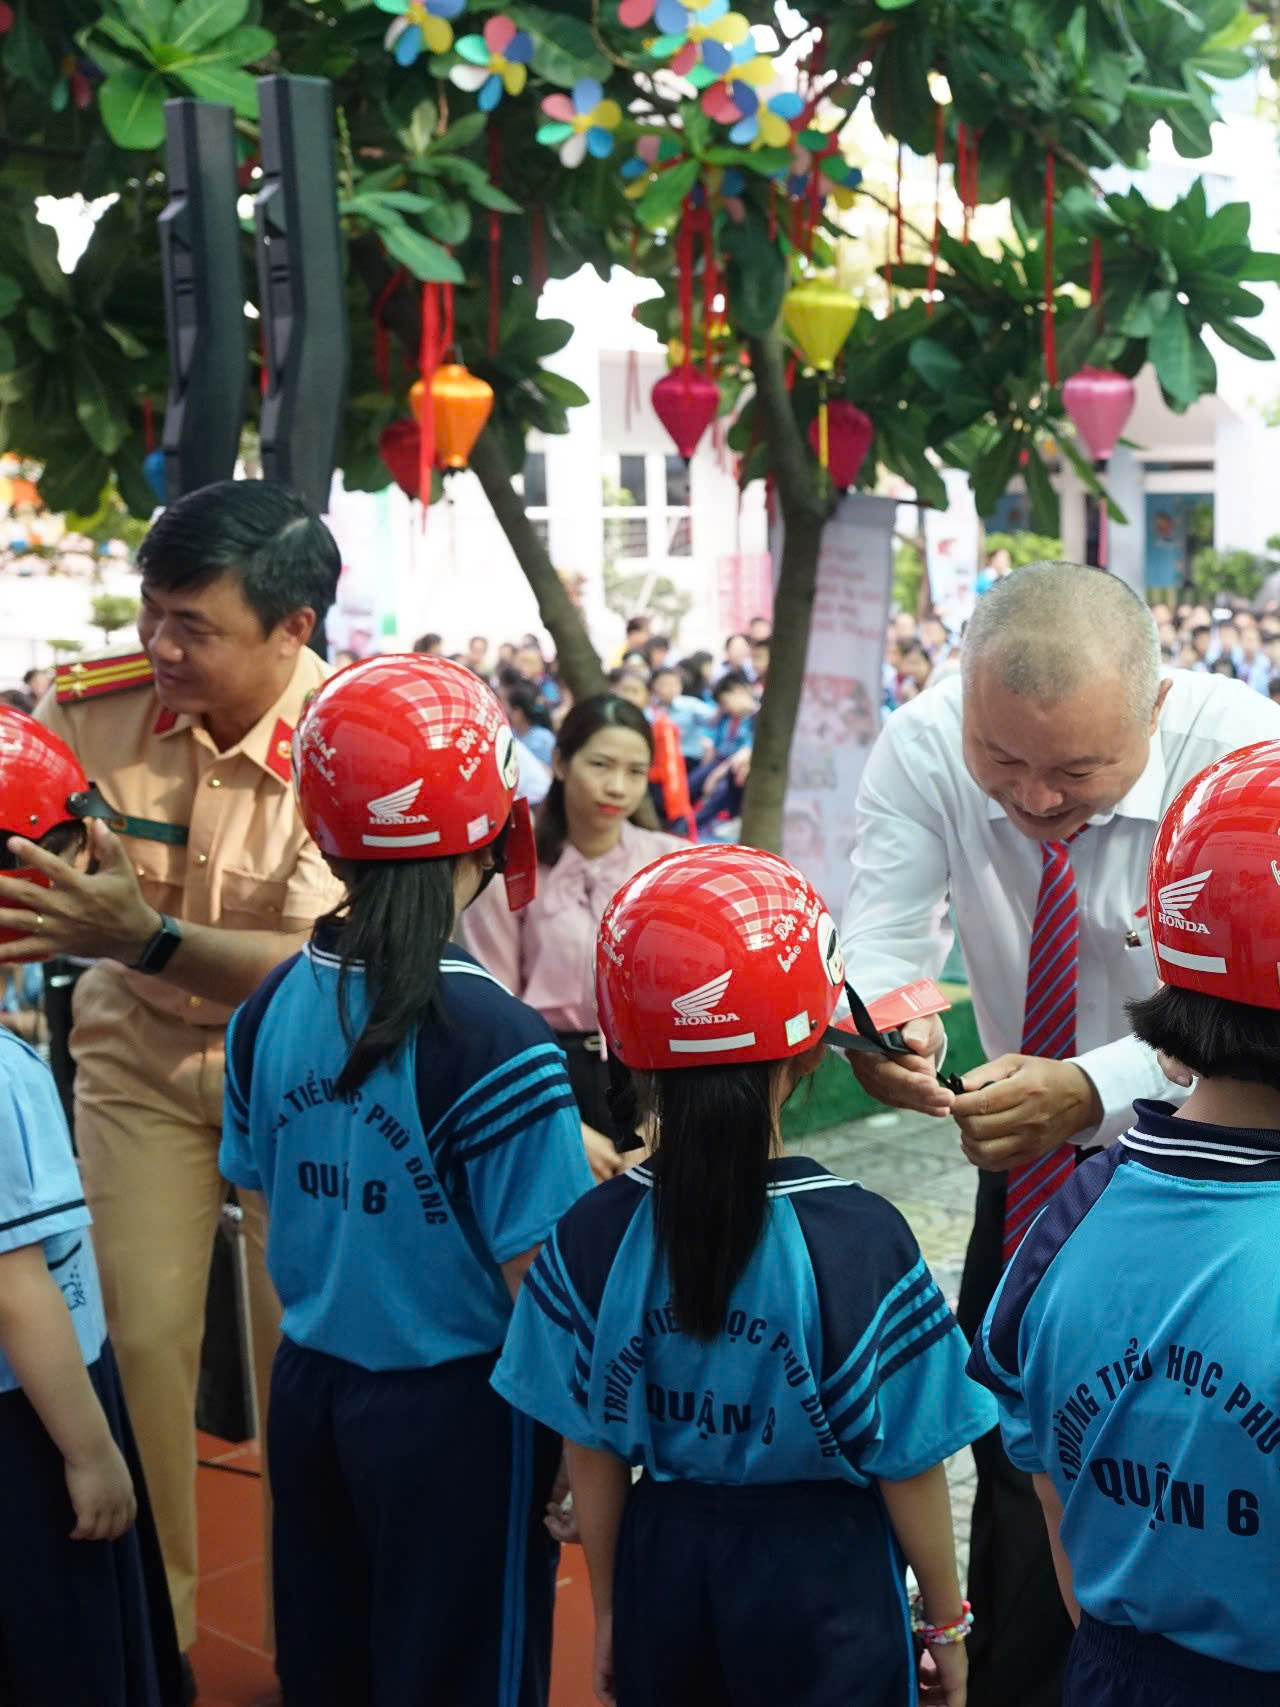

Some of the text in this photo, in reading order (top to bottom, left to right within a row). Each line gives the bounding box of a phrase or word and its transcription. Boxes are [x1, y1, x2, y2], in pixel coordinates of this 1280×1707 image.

[369, 815, 429, 825] HONDA
[1158, 912, 1211, 935] HONDA
[674, 1013, 740, 1026] HONDA
[363, 1180, 387, 1215] 6
[727, 1309, 768, 1345] ỌC
[1165, 1344, 1223, 1399] HỌC
[646, 1384, 751, 1440] QUẬN
[1227, 1488, 1260, 1536] 6
